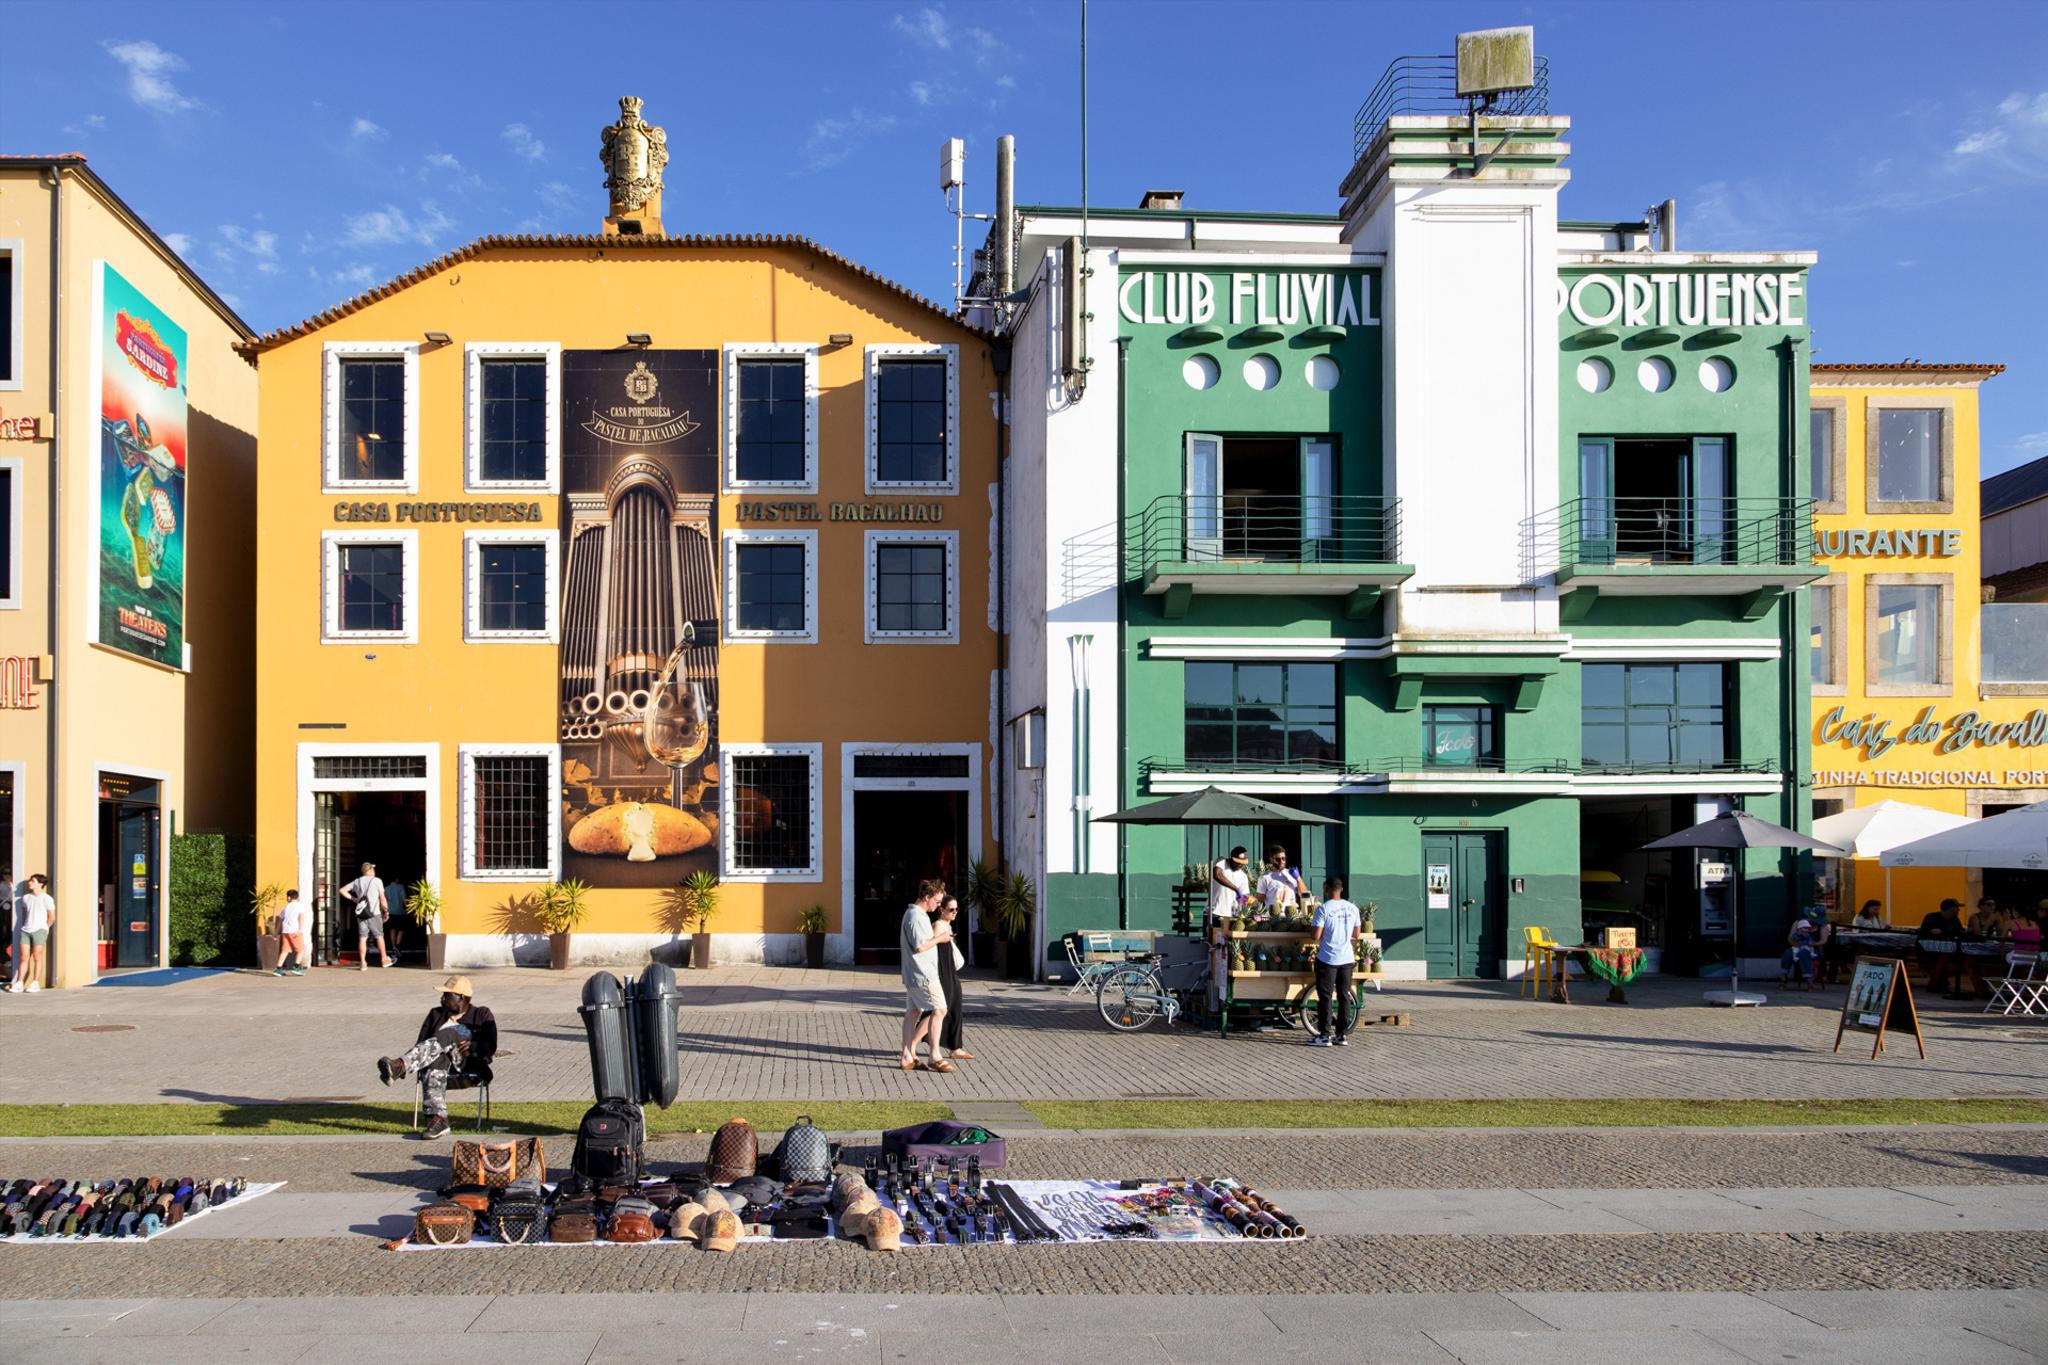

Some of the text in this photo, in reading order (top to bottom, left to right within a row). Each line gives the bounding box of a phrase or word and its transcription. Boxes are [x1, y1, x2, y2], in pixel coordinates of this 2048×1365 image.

[1119, 271, 1381, 326] CLUB FLUVIAL
[126, 337, 169, 380] SARDINE
[610, 406, 671, 418] CASA PORTUGUESA
[593, 417, 690, 442] PASTEL DE BACALHAU
[334, 501, 543, 523] CASA PORTUGUESA
[737, 501, 944, 523] PASTEL BACALHAU
[118, 606, 167, 640] THEATERS
[1820, 706, 1898, 760] Cais
[1906, 704, 1943, 744] do
[1873, 769, 2000, 786] TRADICIONAL
[1707, 867, 1730, 875] ATM
[1862, 970, 1885, 981] FADO
